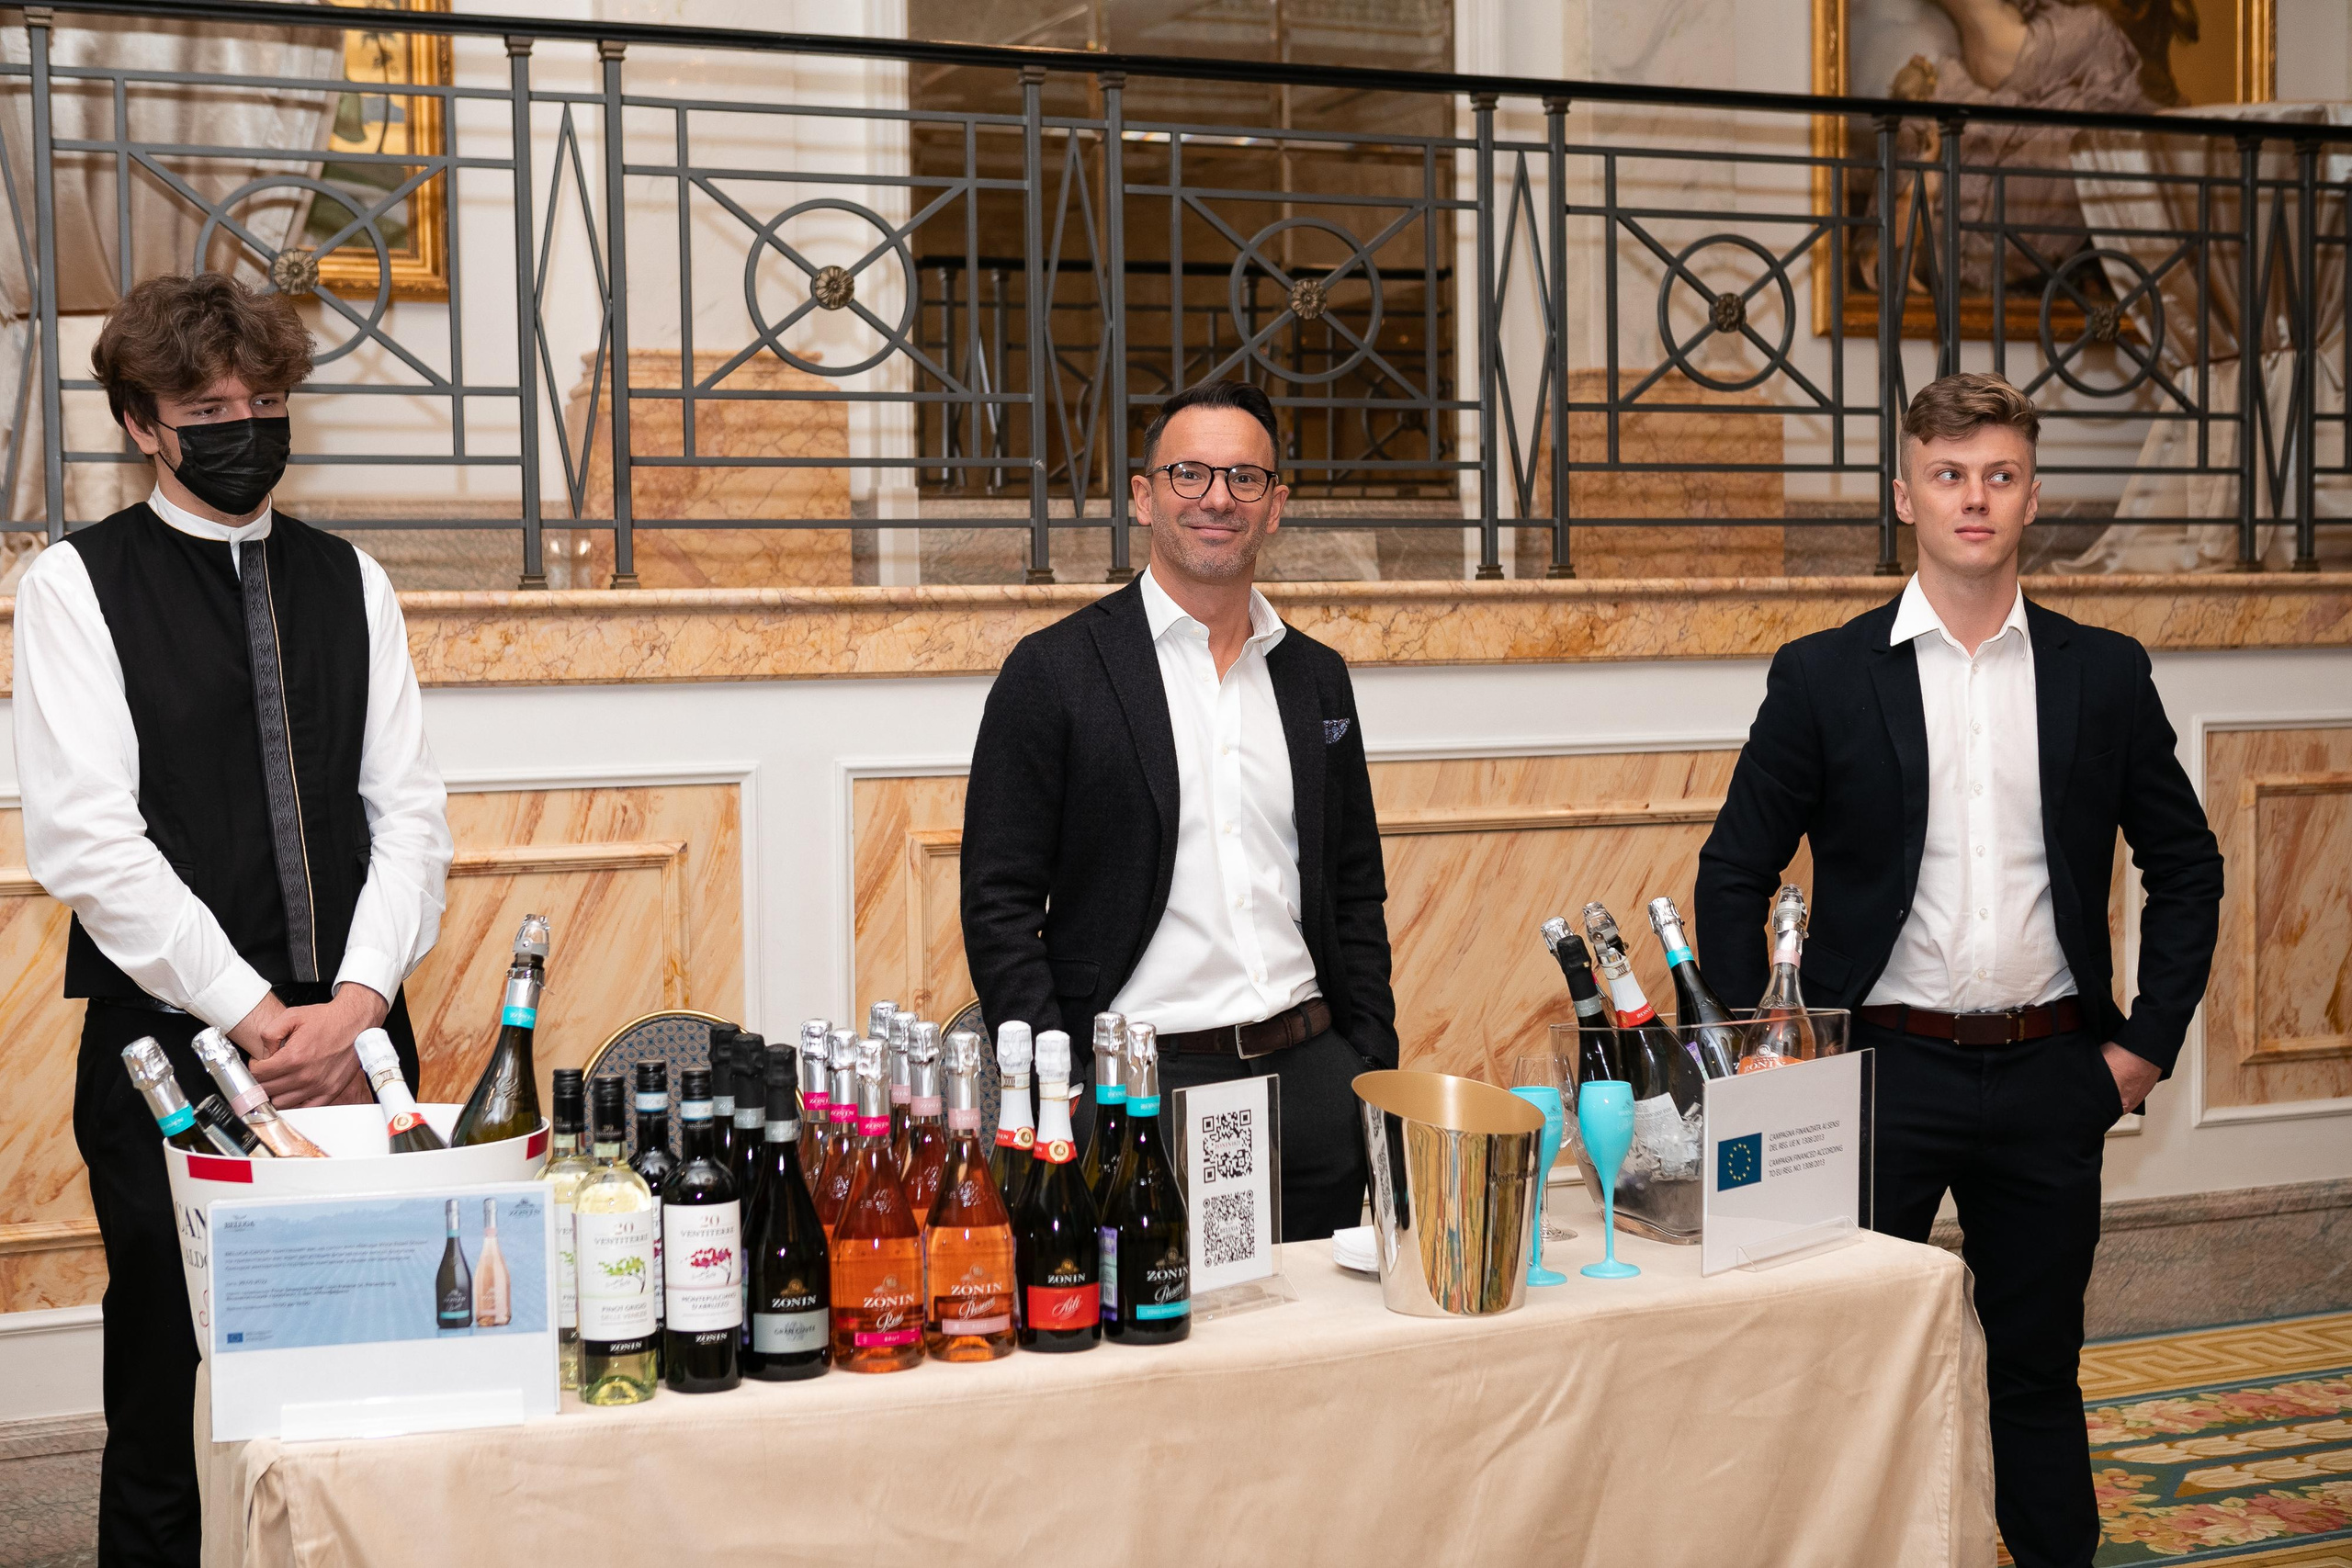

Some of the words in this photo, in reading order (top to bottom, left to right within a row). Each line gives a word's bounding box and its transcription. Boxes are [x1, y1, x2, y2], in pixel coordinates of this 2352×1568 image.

[700, 1213, 720, 1228] 20
[614, 1221, 635, 1235] 20
[680, 1226, 734, 1238] VENTITERRE
[594, 1233, 649, 1247] VENTITERRE
[1047, 1272, 1086, 1284] ZONIN
[1147, 1266, 1189, 1281] ZONIN
[951, 1281, 1002, 1296] ZONIN
[681, 1292, 737, 1303] MONTEPULCIANO
[772, 1295, 817, 1308] ZONIN
[864, 1293, 915, 1308] ZONIN
[695, 1332, 728, 1343] ZONIN
[609, 1341, 642, 1352] ZONIN
